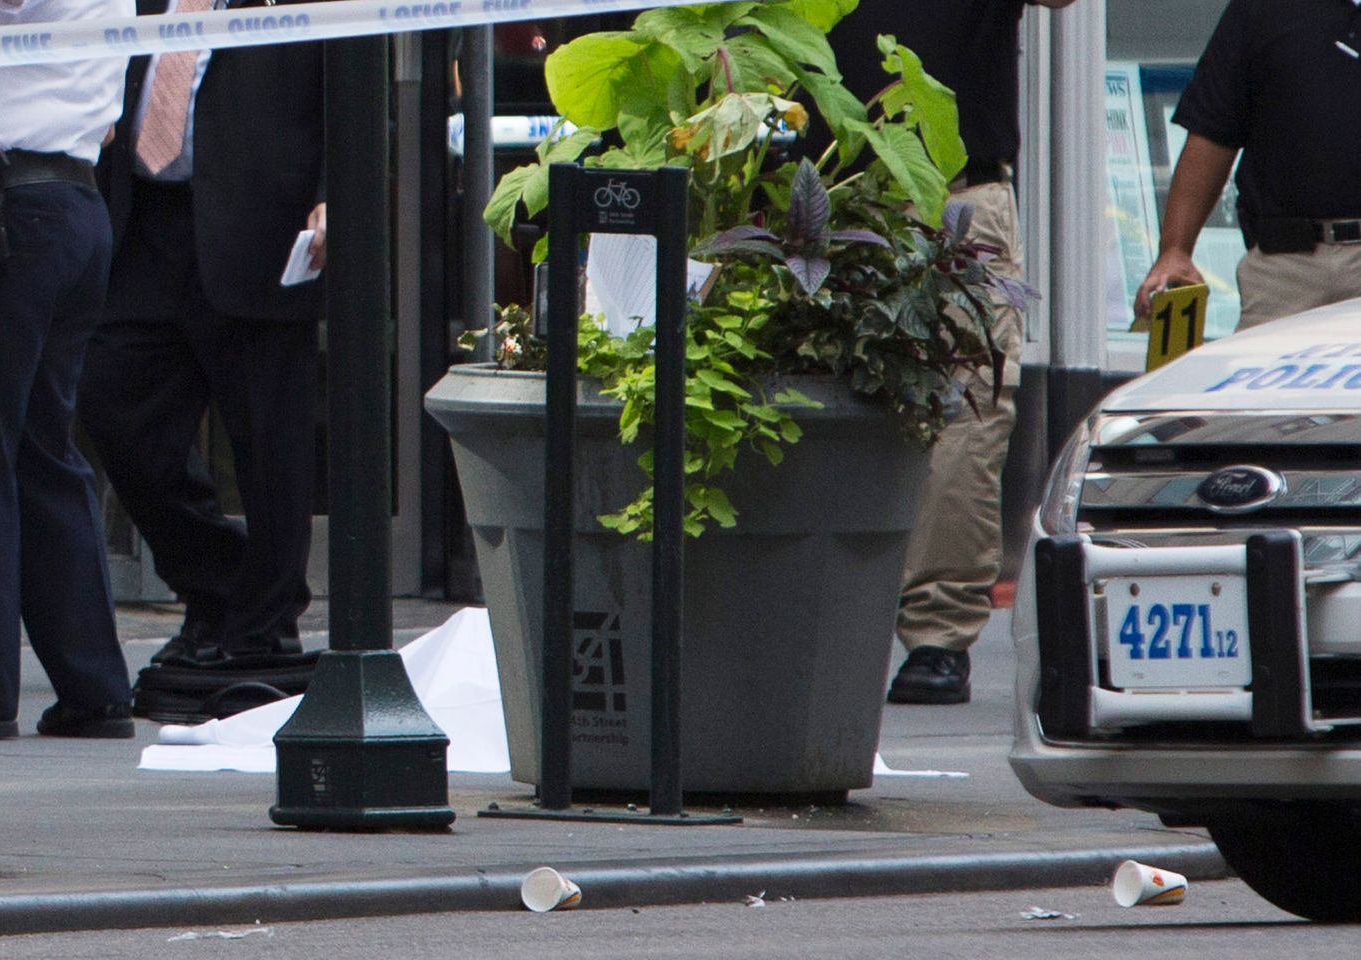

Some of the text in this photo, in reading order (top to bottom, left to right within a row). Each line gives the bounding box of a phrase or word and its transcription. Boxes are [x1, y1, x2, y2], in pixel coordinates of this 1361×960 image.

[1155, 296, 1199, 356] 11
[1211, 473, 1257, 496] Ford
[1119, 603, 1238, 660] 4271 12
